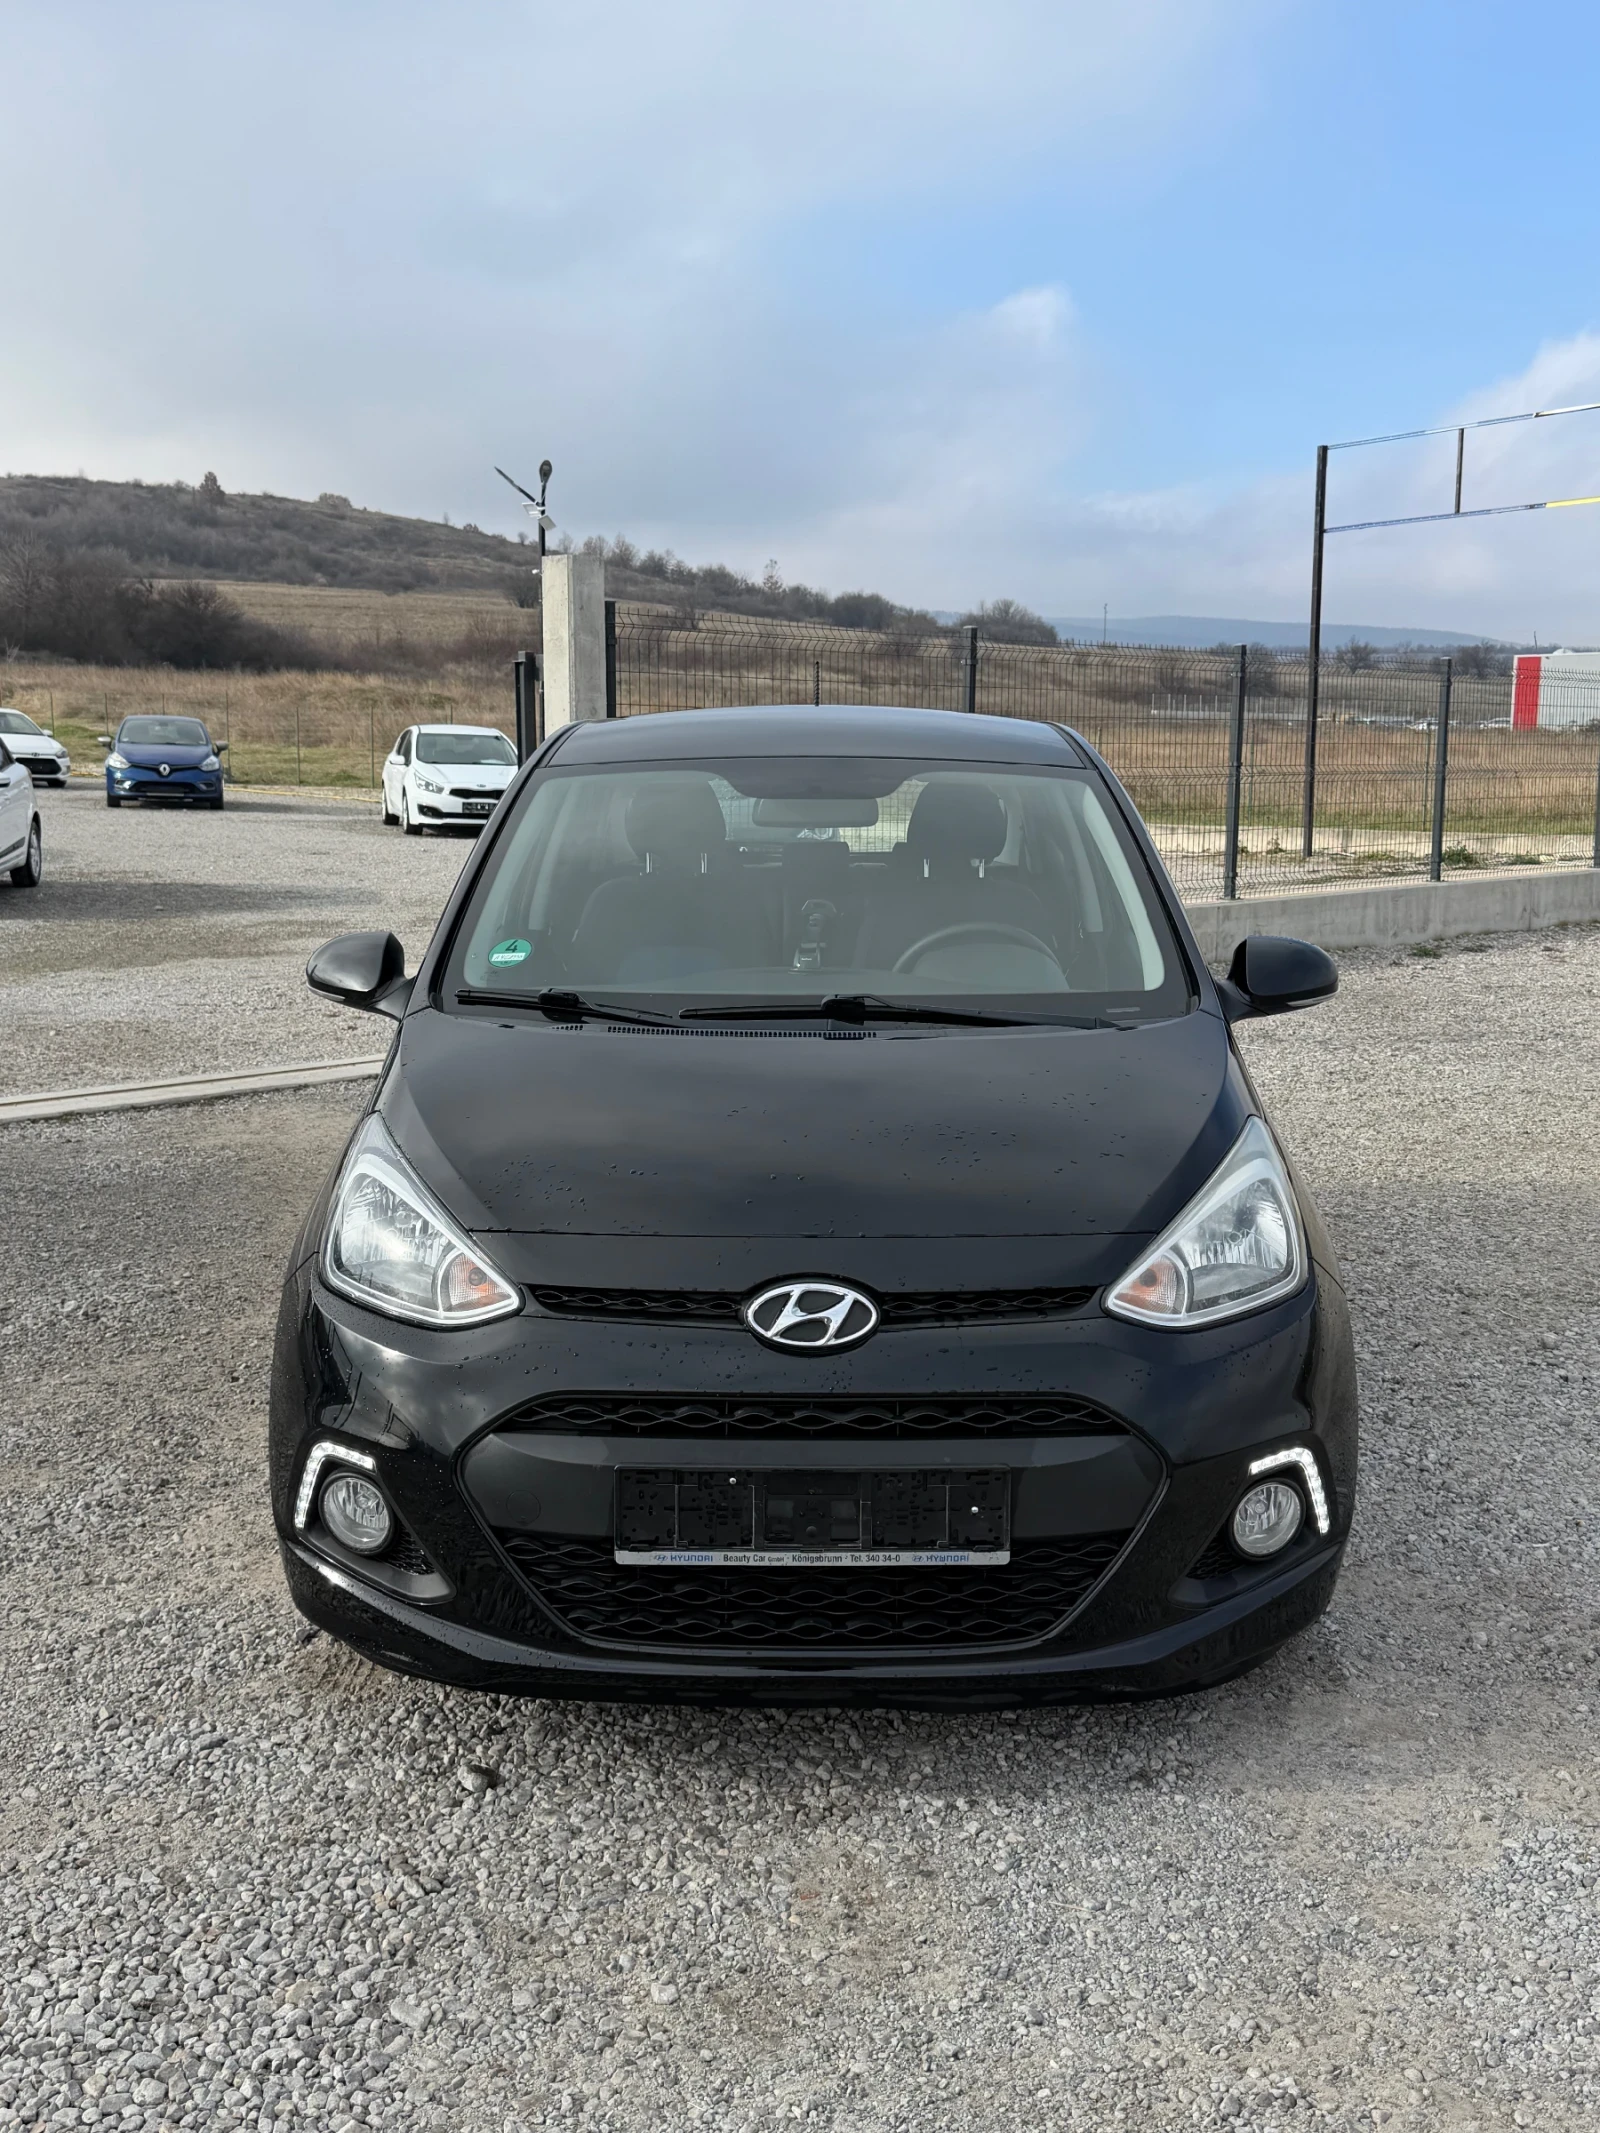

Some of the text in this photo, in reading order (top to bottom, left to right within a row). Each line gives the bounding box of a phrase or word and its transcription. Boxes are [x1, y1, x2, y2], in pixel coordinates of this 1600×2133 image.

[505, 939, 519, 953] 4
[670, 1554, 713, 1562] HYUNDAI
[723, 1554, 751, 1564] Beauty
[753, 1554, 766, 1562] Car
[792, 1554, 843, 1564] Königsbrunn
[850, 1554, 863, 1562] Tel.
[865, 1554, 880, 1562] 340
[882, 1554, 901, 1562] 34-0
[926, 1554, 970, 1562] HYUNDAI
